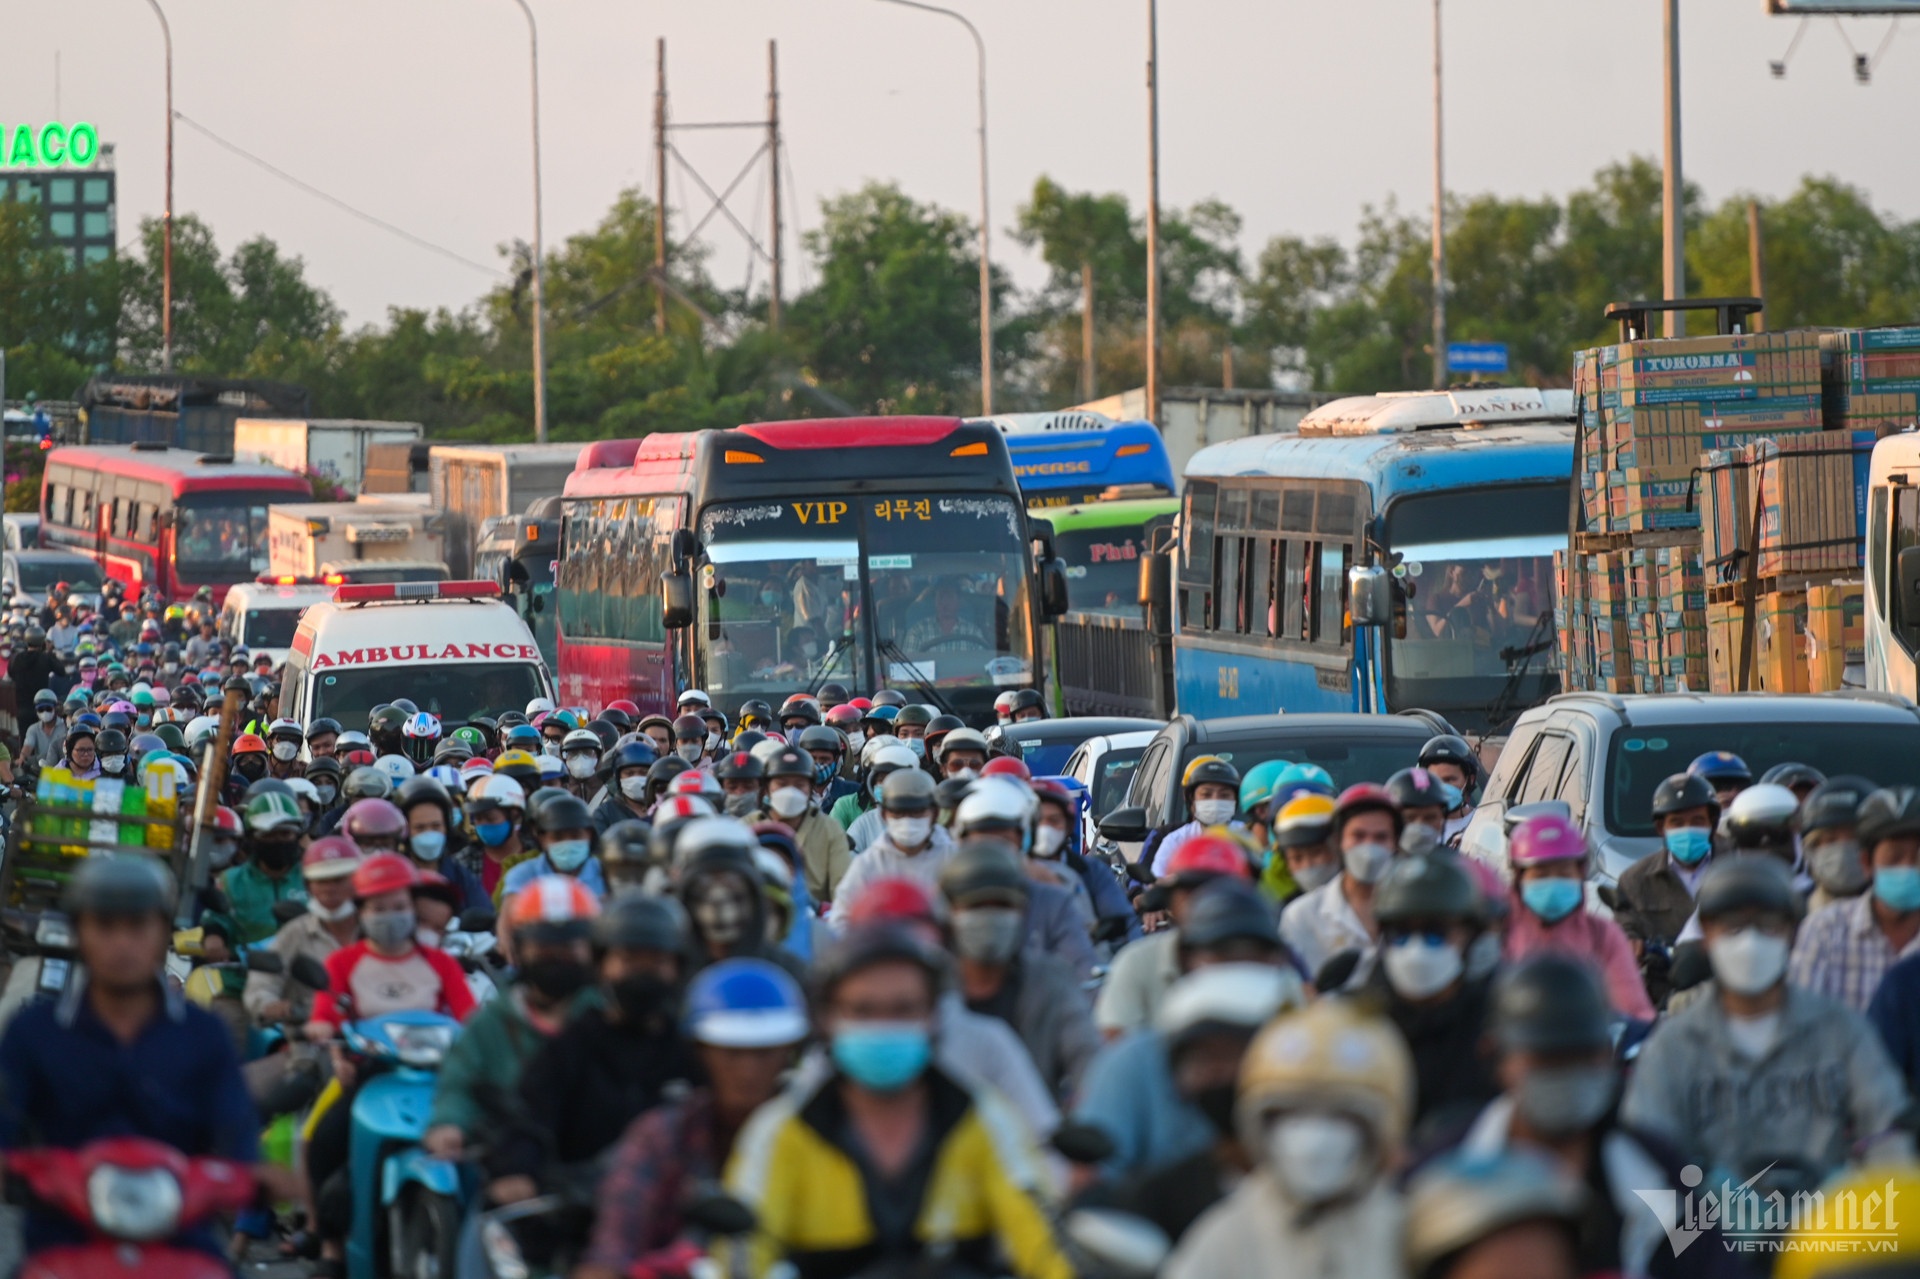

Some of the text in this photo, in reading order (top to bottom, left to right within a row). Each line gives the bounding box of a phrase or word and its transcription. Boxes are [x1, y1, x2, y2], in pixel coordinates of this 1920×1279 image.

[0, 121, 98, 168] ACO
[1460, 401, 1542, 414] DANKO
[791, 501, 848, 524] VIP
[874, 498, 931, 520] 리무진
[312, 643, 539, 669] AMBULANCE
